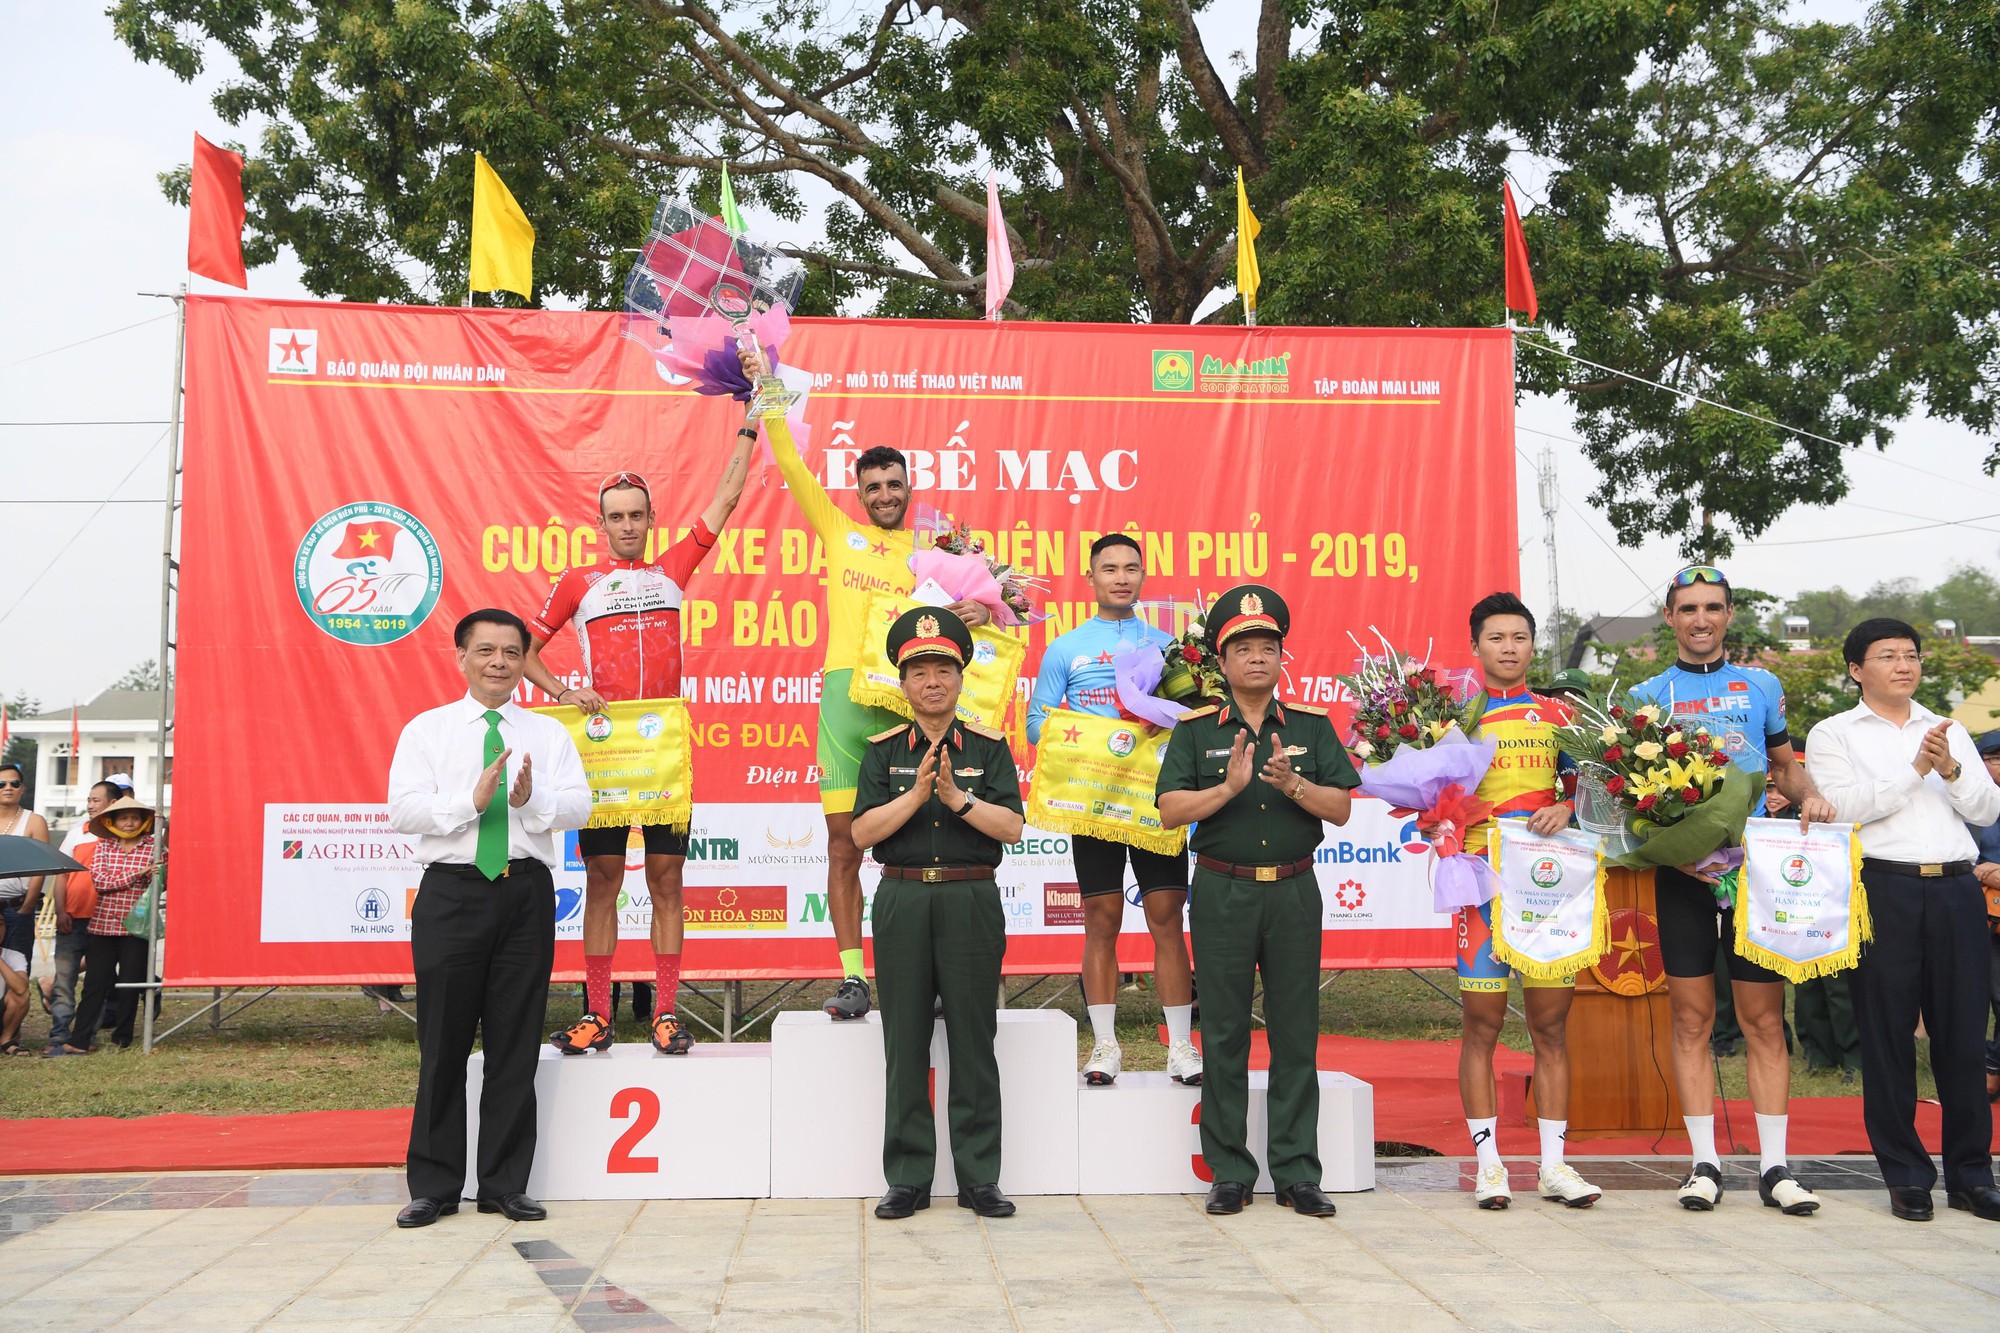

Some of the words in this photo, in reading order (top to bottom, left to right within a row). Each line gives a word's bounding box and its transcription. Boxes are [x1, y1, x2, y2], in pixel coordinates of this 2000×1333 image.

[327, 359, 355, 376] BÁO
[361, 361, 400, 378] QUÂN
[404, 362, 427, 382] ĐỘI
[433, 363, 472, 381] NHÂN
[477, 364, 505, 382] DÂN
[847, 371, 868, 388] MÔ
[872, 371, 888, 388] TÔ
[893, 369, 918, 388] THỂ
[921, 375, 955, 389] THAO
[960, 372, 987, 392] VIỆT
[992, 376, 1022, 390] NAM
[1201, 383, 1289, 393] CORPORATION
[1314, 378, 1338, 397] TẬP
[1342, 378, 1378, 394] ĐOÀN
[1382, 382, 1406, 394] MAI
[1411, 382, 1439, 394] LINH
[901, 421, 976, 491] BẾ
[995, 449, 1138, 504] MẠC
[482, 516, 597, 584] CUỘC
[1189, 512, 1268, 577] PHỦ
[1310, 533, 1419, 583] 2019,
[714, 529, 766, 574] XE
[781, 529, 828, 585] ĐẠ
[328, 619, 360, 629] 1954
[374, 619, 406, 629] 2019
[734, 591, 817, 647] BÁO
[706, 671, 763, 703] NGÀY
[773, 667, 824, 704] CHIẾ
[1079, 688, 1117, 707] CHUN
[1725, 714, 1748, 723] NAI
[740, 723, 809, 747] ĐUA
[1490, 756, 1511, 769] NG
[598, 770, 627, 778] CHUNG
[746, 765, 797, 784] Điện
[639, 791, 661, 799] BIDV
[1106, 784, 1133, 796] CHUNG
[303, 813, 314, 822] CƠ
[317, 814, 342, 823] QUAN,
[345, 813, 361, 822] ĐƠN
[365, 814, 372, 824] VỊ
[1140, 816, 1161, 828] BIDV
[307, 844, 414, 859] AGRIBAN
[748, 854, 788, 864] MƯỜNG
[1011, 858, 1026, 867] Sức
[1032, 858, 1045, 867] bật
[1048, 858, 1067, 867] Việt
[1047, 890, 1080, 907] Khang
[684, 906, 705, 921] ÔN
[710, 910, 746, 921] HOA
[751, 909, 784, 921] SEN
[351, 925, 367, 933] THAI
[371, 925, 394, 933] HUNG
[1550, 928, 1569, 937] BIDV
[1807, 930, 1825, 938] BIDV
[607, 1086, 661, 1174] 2
